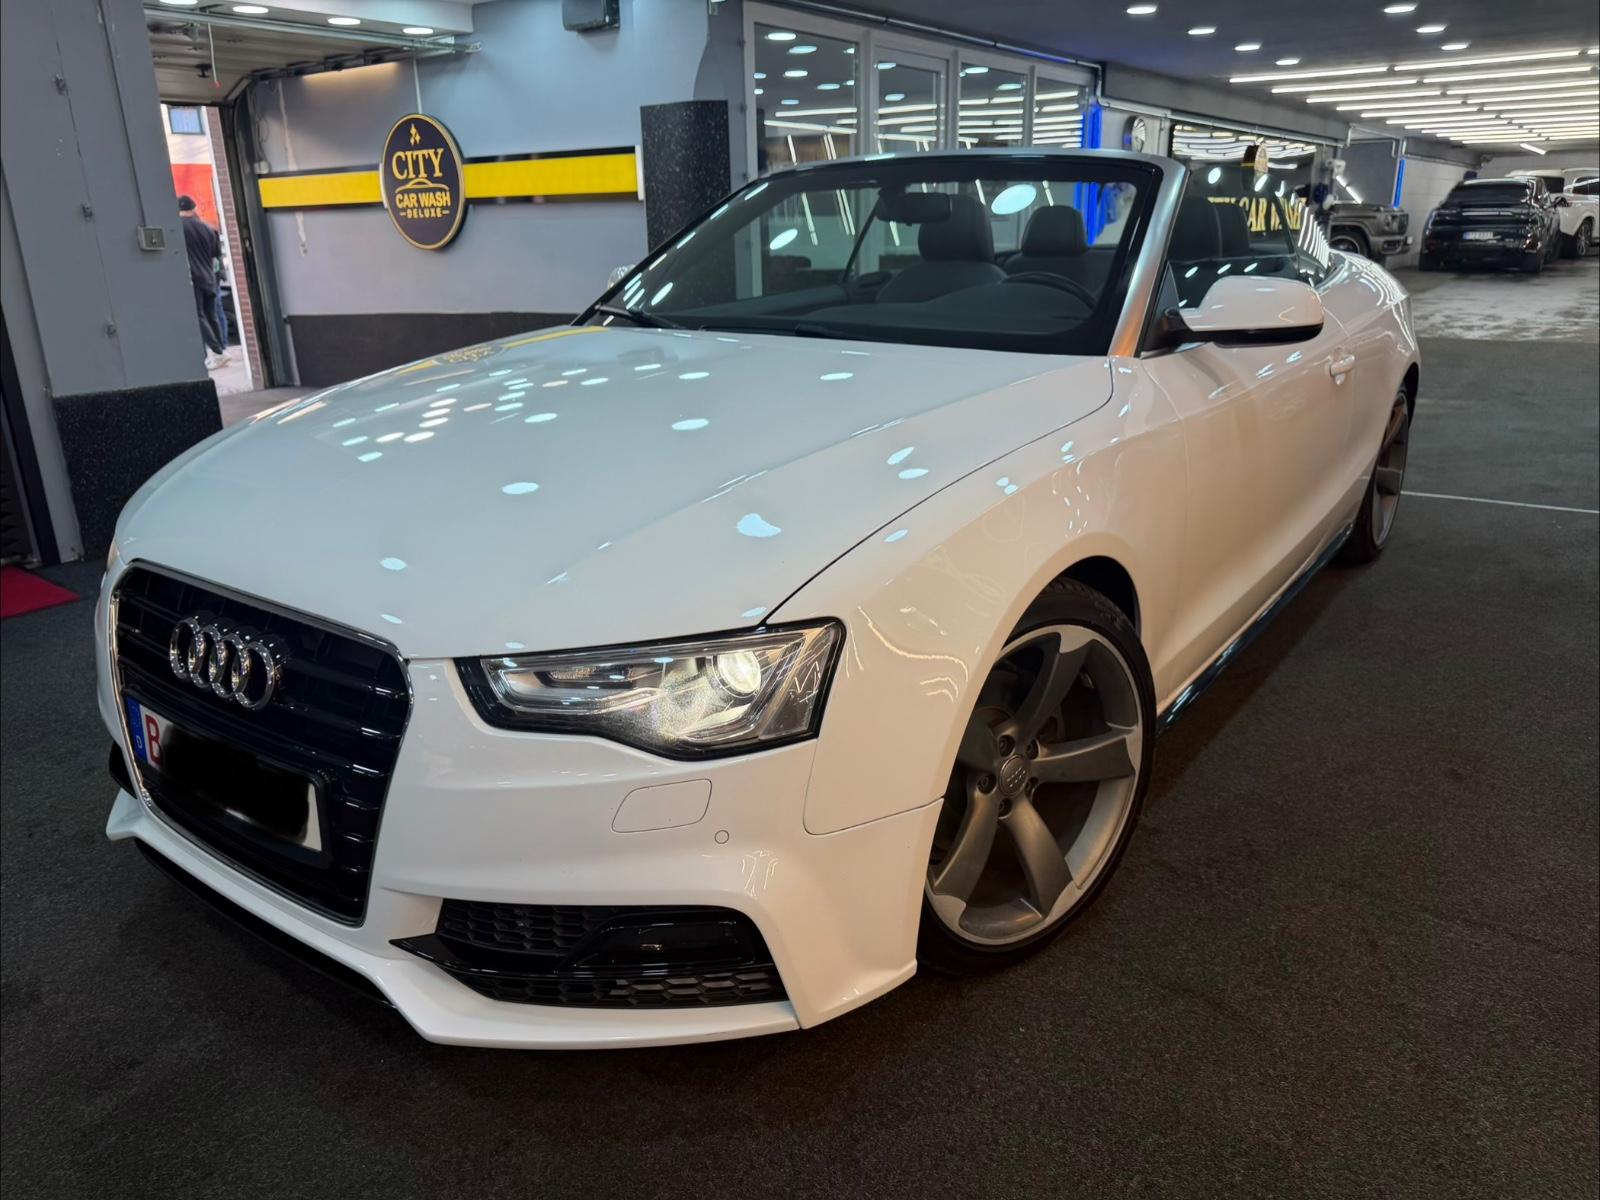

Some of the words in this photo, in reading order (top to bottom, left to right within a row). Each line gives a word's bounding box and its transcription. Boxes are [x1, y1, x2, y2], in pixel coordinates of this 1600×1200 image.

[392, 148, 444, 179] CITY
[396, 193, 418, 209] CAR
[418, 191, 450, 207] WASH
[406, 208, 442, 218] DELUXE
